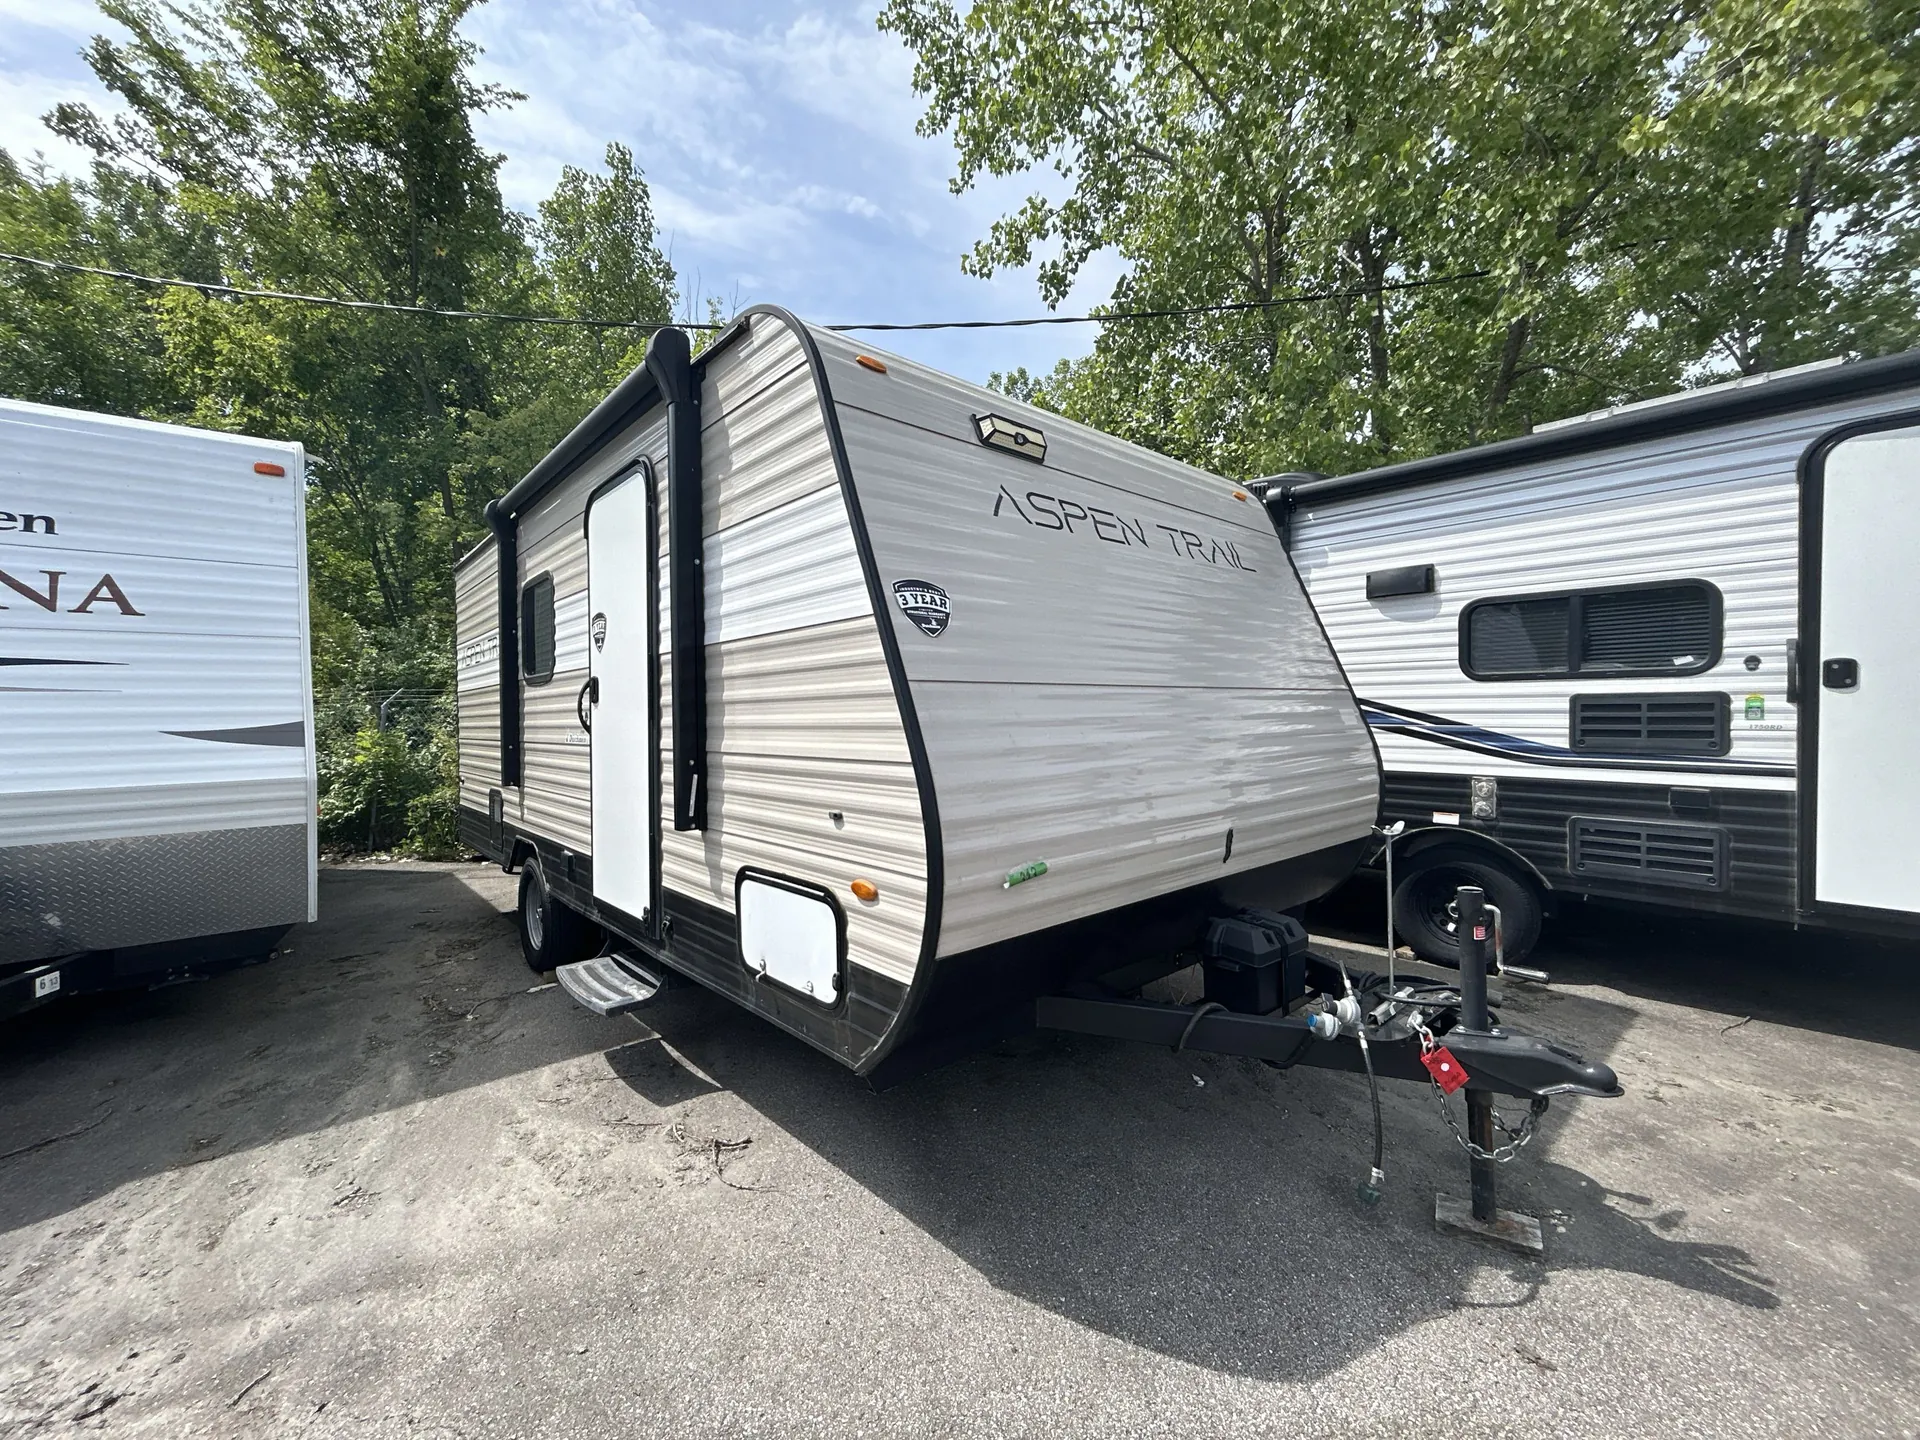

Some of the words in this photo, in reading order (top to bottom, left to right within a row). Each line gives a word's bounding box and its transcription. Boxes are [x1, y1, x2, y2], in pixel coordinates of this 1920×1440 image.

[993, 484, 1149, 548] ASPEN
[1156, 524, 1257, 573] TRAIL
[899, 594, 909, 606] 3
[910, 593, 948, 610] YEAR
